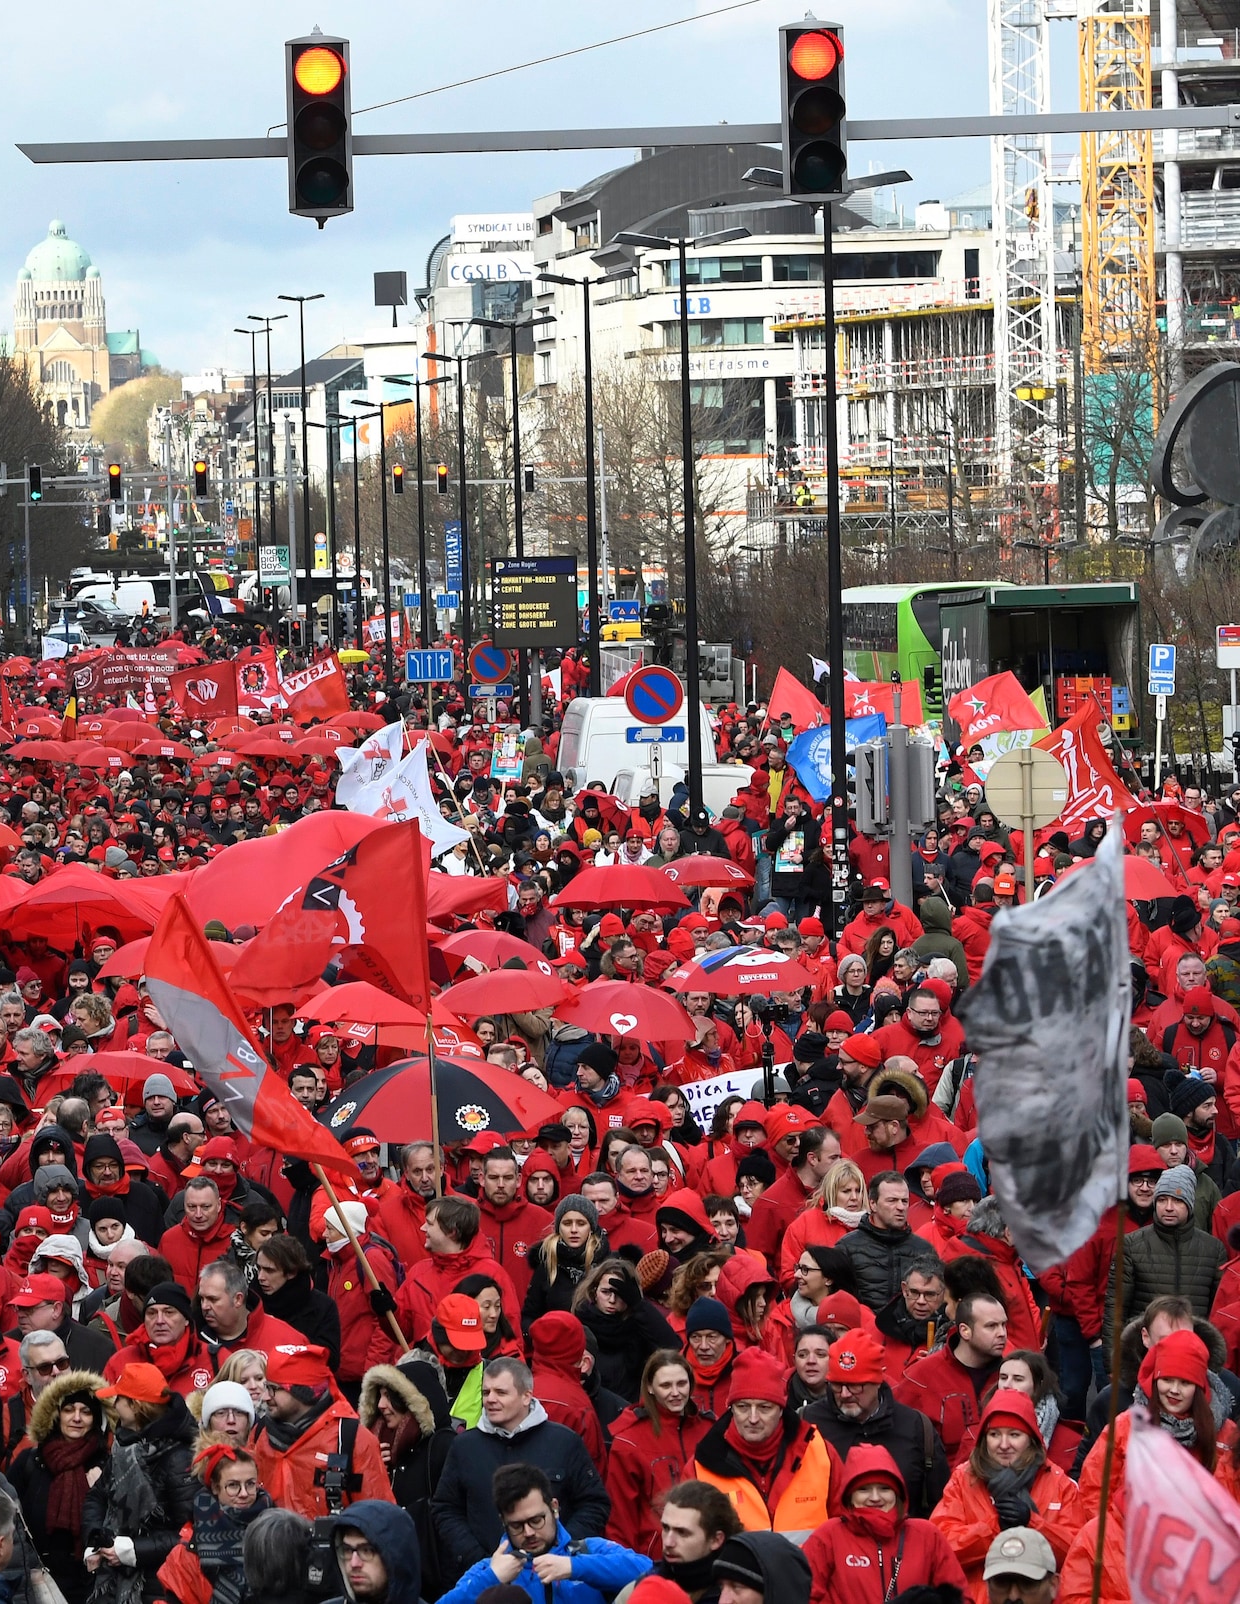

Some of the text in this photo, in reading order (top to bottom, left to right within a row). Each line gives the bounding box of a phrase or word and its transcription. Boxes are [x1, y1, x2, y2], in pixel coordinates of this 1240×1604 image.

[450, 264, 508, 281] CGSLB
[709, 358, 770, 371] Erasme
[261, 546, 288, 558] flagey
[261, 561, 282, 571] days
[495, 561, 505, 573] P
[501, 585, 523, 593] CENTRE
[502, 603, 516, 611] ZONE
[502, 612, 516, 620] ZONE
[502, 621, 517, 629] ZONE
[1155, 647, 1170, 667] P
[1151, 684, 1159, 692] 15
